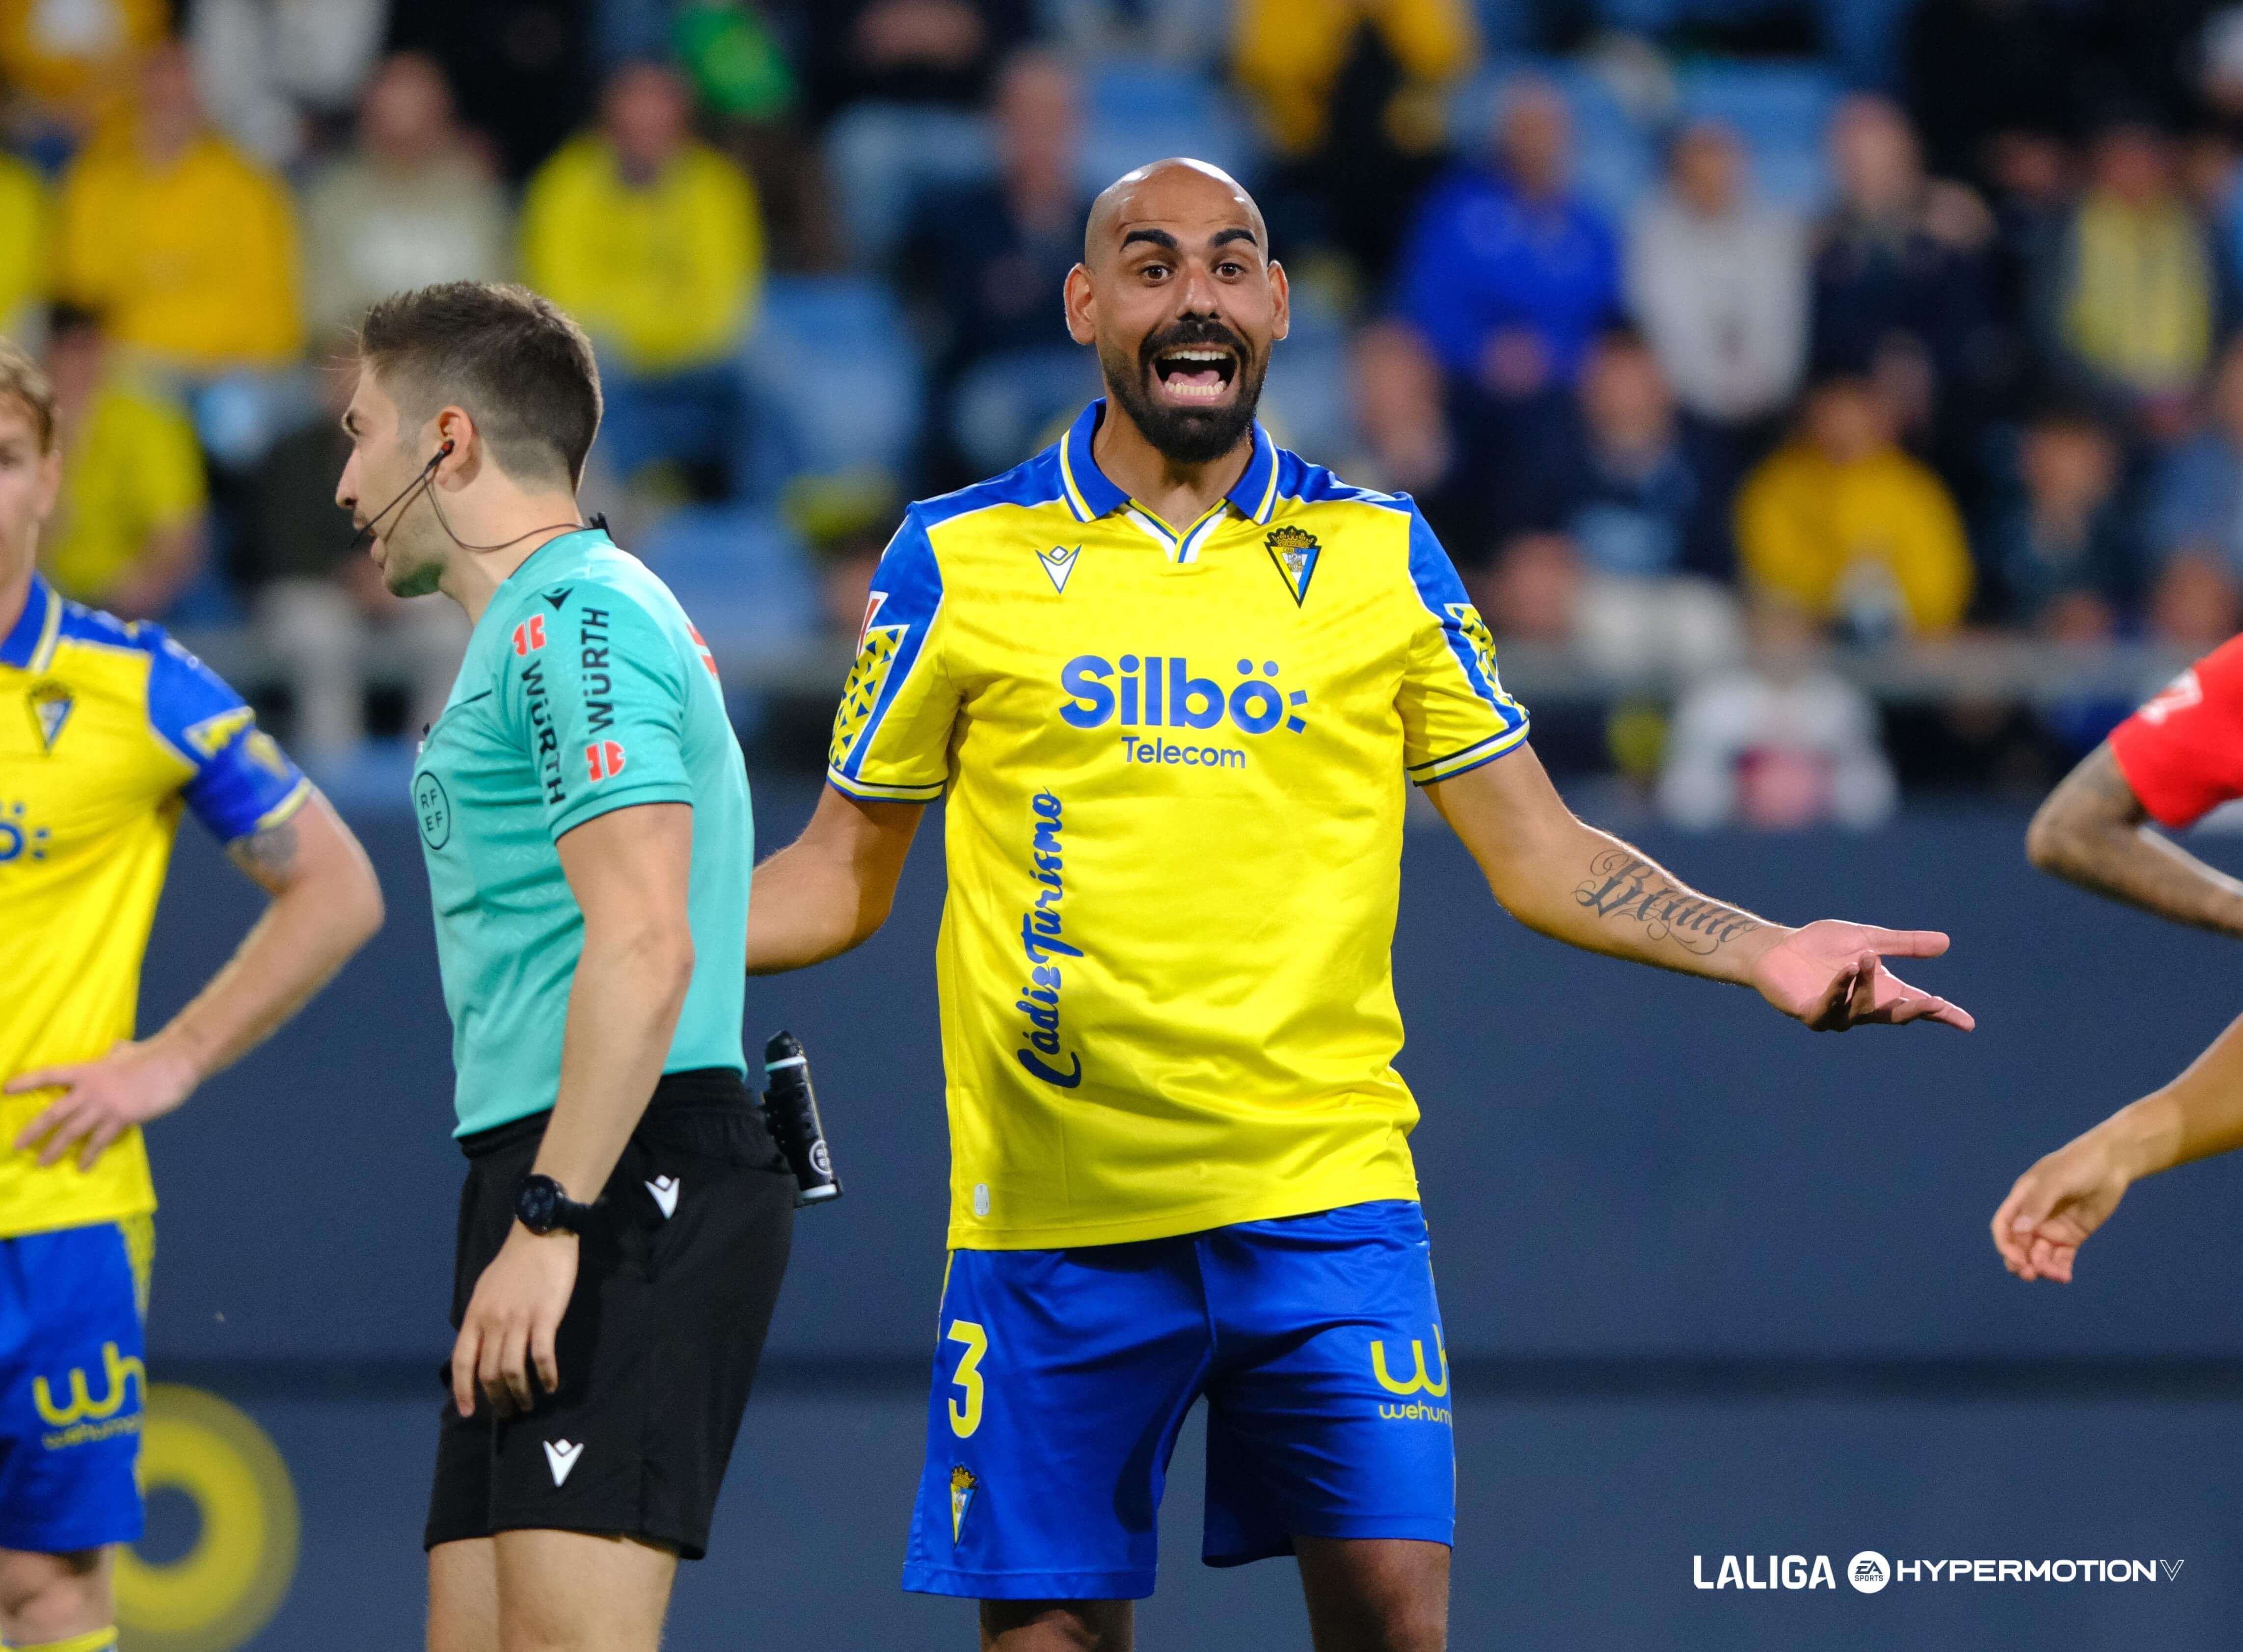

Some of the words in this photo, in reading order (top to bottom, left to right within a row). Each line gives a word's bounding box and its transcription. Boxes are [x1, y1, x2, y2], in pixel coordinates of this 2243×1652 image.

[582, 607, 614, 734] WÜRTH
[1059, 654, 1283, 734] Silbö
[521, 659, 566, 805] WÜRTH
[1121, 737, 1246, 769] Telecom
[947, 1319, 988, 1439] 3
